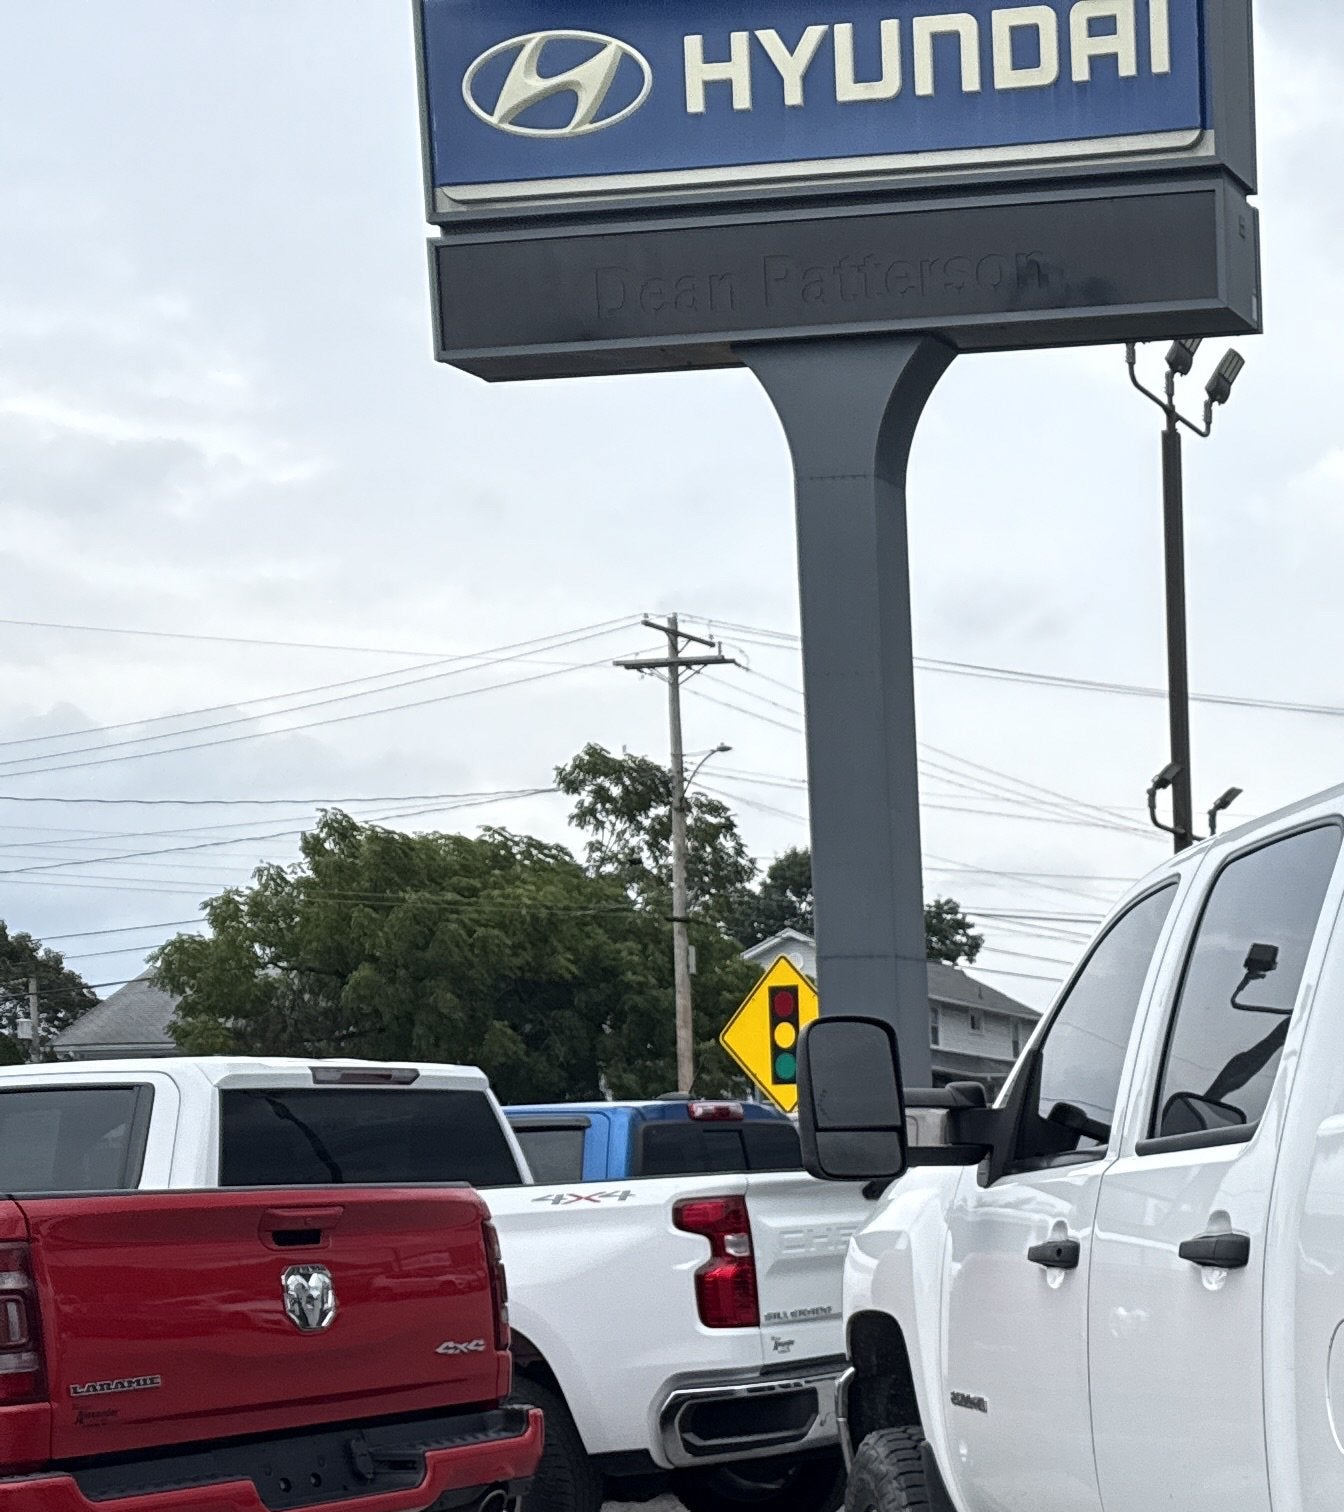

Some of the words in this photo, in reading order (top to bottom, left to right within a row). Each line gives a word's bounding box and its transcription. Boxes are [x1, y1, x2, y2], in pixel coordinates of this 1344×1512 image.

[683, 0, 1171, 114] HYUNDAI
[592, 265, 737, 319] Dean
[761, 249, 1045, 309] Patterson
[71, 1376, 161, 1396] LARAMIE
